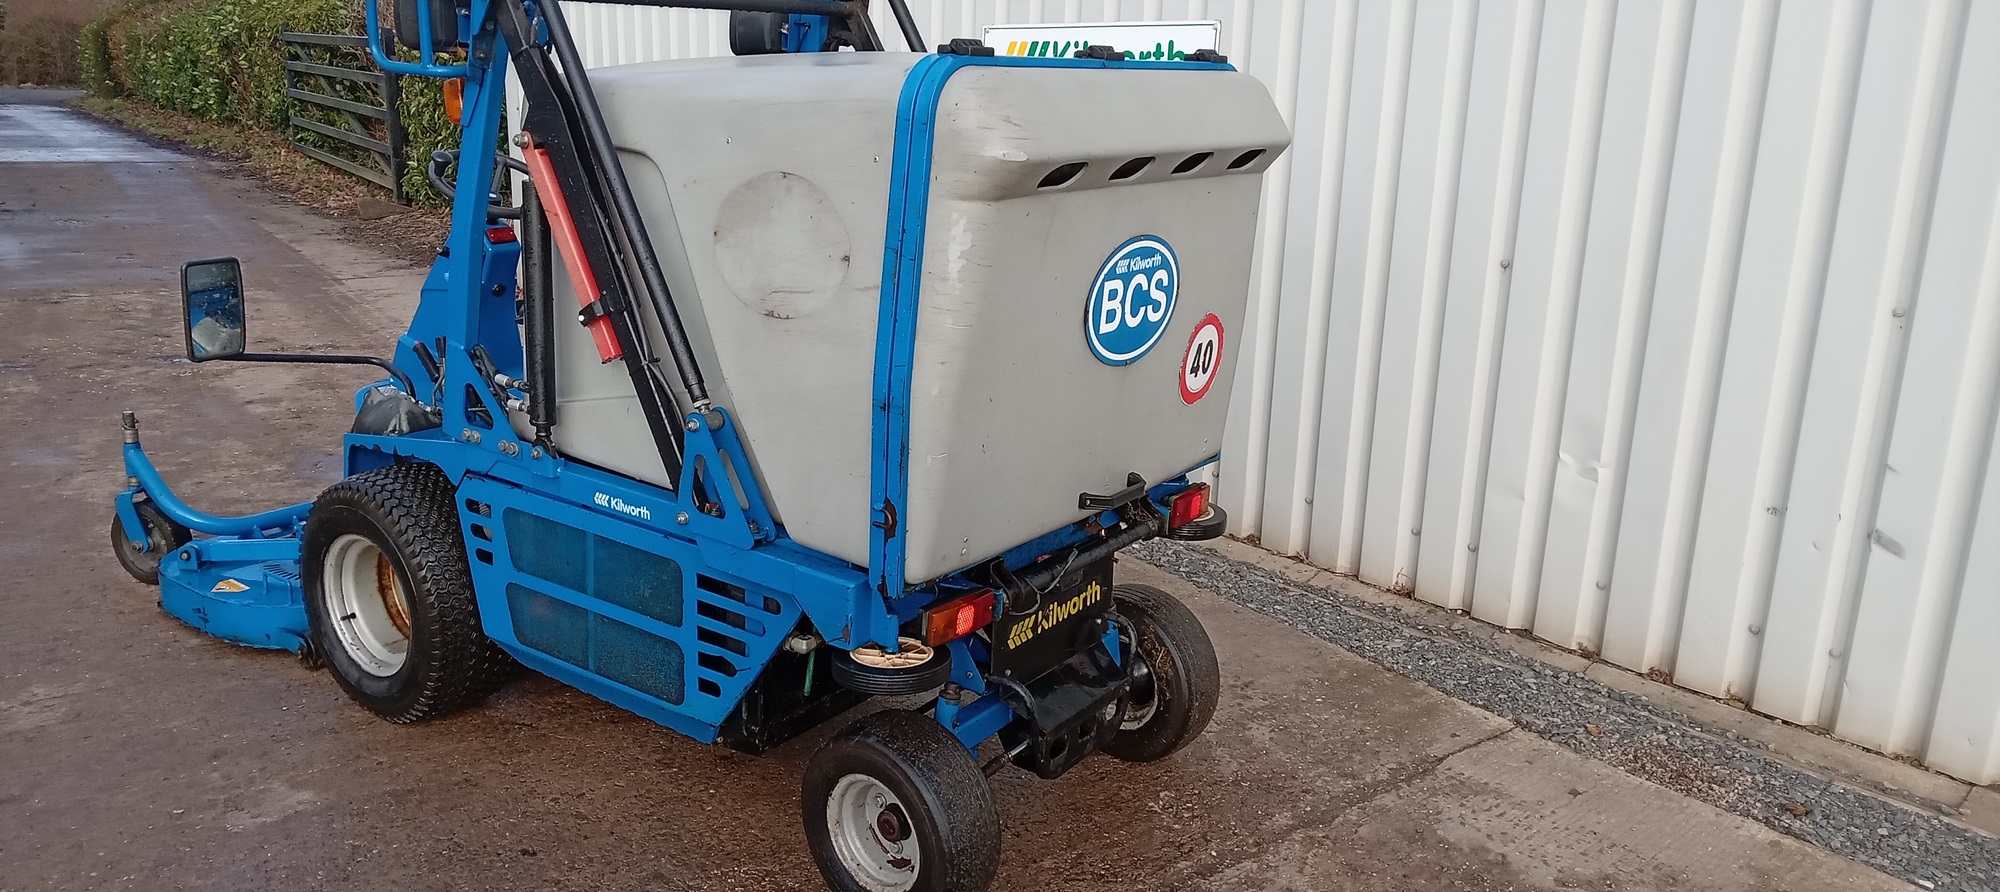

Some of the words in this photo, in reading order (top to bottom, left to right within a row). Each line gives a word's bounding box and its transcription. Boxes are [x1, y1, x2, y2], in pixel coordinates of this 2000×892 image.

[1130, 253, 1161, 272] Kilworth
[1099, 269, 1168, 334] BCS
[1190, 340, 1213, 378] 40
[610, 497, 650, 520] Kilworth
[1038, 581, 1100, 634] Kilworth
